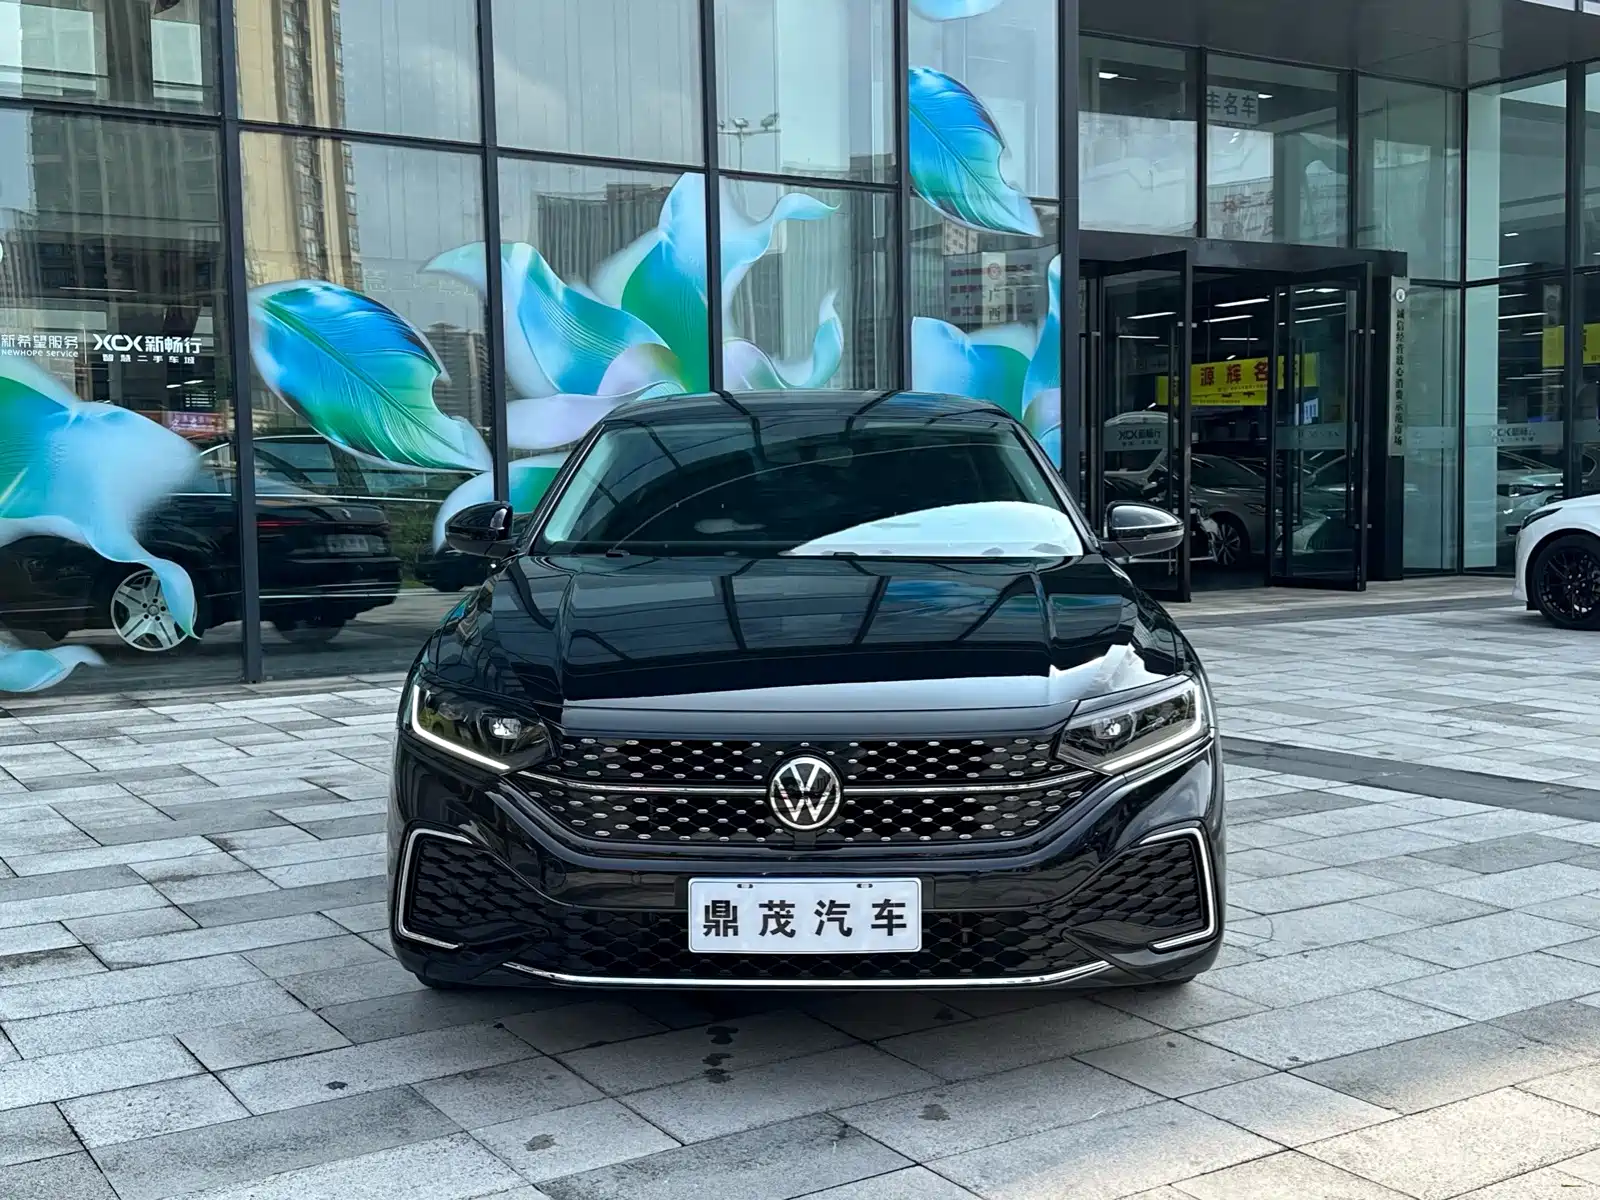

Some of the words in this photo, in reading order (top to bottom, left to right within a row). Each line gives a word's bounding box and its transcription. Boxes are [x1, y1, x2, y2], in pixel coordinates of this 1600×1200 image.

[1, 334, 79, 349] 新希望服务
[145, 336, 202, 354] 新畅行
[102, 353, 196, 365] 智慧二手车城
[703, 899, 907, 938] 鼎茂汽车
